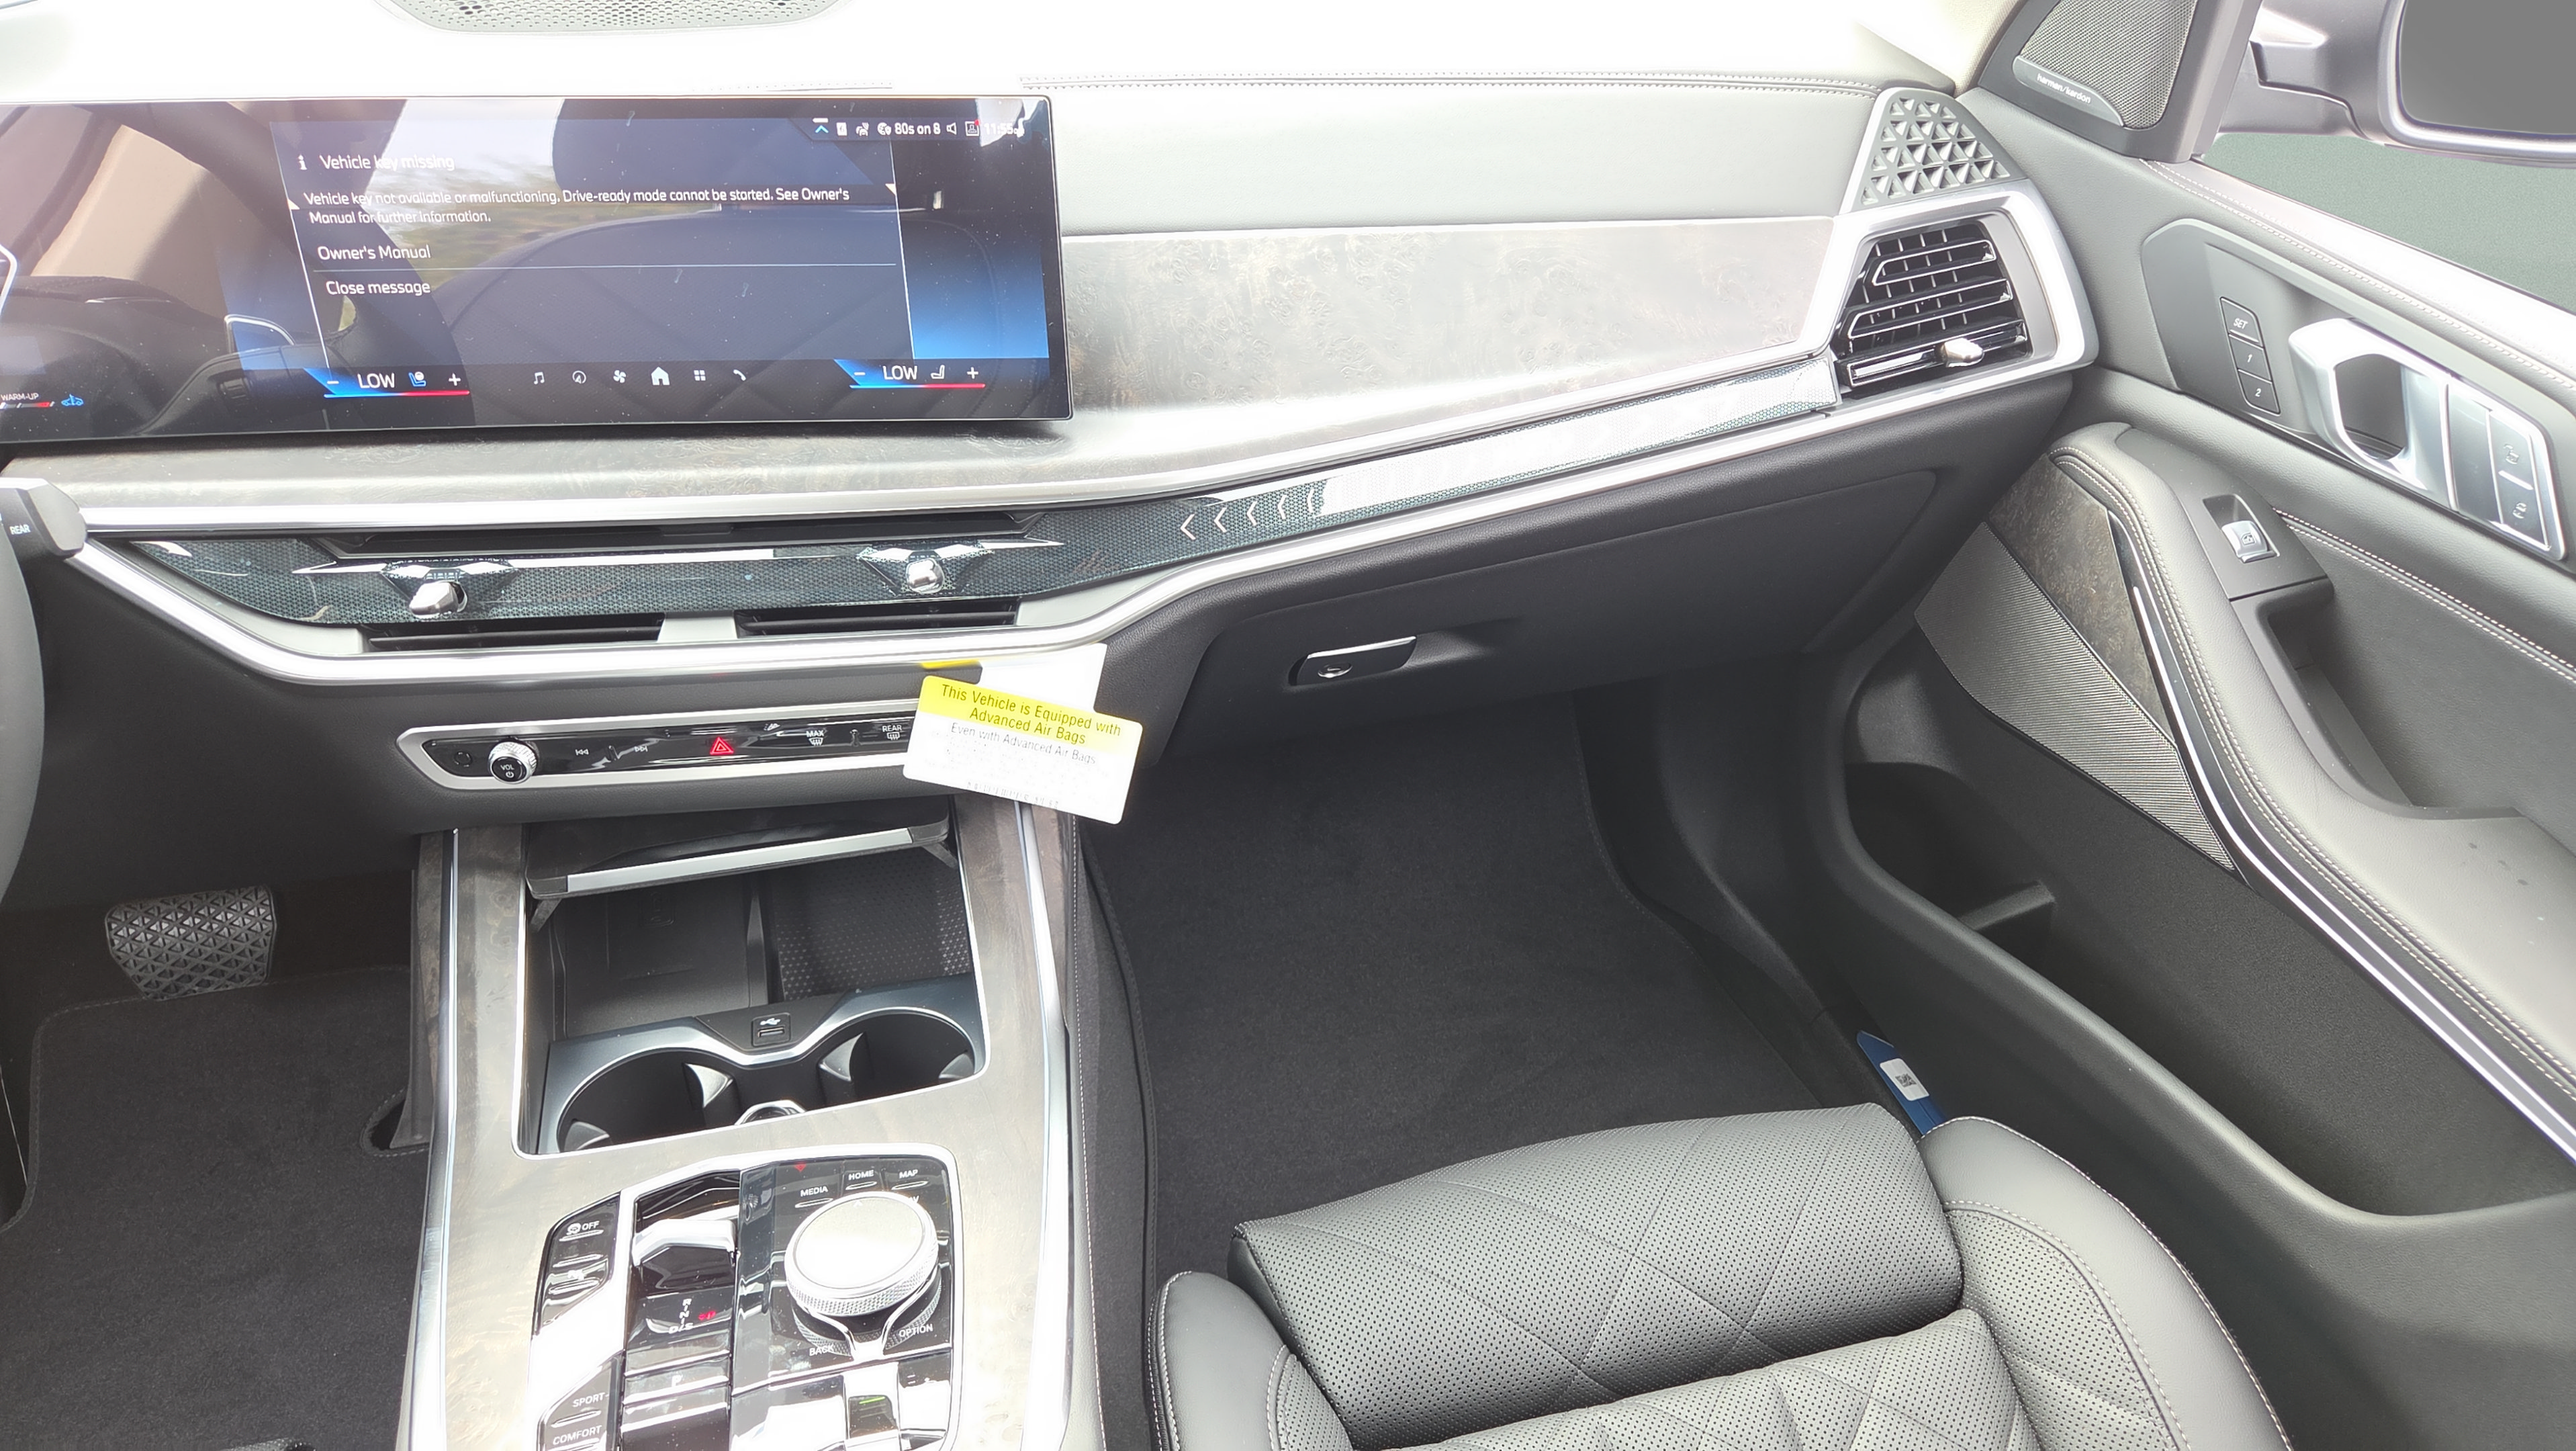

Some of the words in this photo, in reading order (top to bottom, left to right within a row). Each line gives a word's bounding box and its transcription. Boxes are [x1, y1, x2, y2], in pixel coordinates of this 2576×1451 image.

[894, 122, 915, 135] 80s
[917, 125, 931, 134] on
[933, 122, 941, 134] 8
[319, 155, 371, 169] Vehicle
[373, 155, 398, 171] key
[402, 154, 455, 171] missing
[304, 192, 349, 206] Vehicle
[351, 191, 372, 206] key
[375, 193, 397, 204] not
[398, 191, 452, 204] available
[455, 193, 467, 204] or
[469, 189, 561, 206] malfunctioning.
[562, 189, 631, 204] Drive-ready
[633, 189, 667, 202] mode
[670, 189, 710, 202] cannot
[712, 188, 727, 201] be
[729, 188, 774, 201] started.
[776, 187, 799, 201] See
[801, 187, 850, 201] Owner's
[309, 211, 355, 224] Manual
[358, 211, 375, 224] for
[376, 211, 416, 224] further
[419, 210, 492, 223] information.
[317, 245, 377, 261] Owner's
[378, 243, 431, 259] Manual
[326, 280, 365, 296] Close
[367, 282, 431, 297] message
[2233, 317, 2249, 330] SET
[2247, 353, 2253, 363] 1
[882, 365, 918, 380] LOW
[357, 372, 396, 389] LOW
[1, 392, 40, 402] WARM-UP
[2255, 388, 2262, 398] 2
[9, 524, 31, 535] REAR
[941, 683, 967, 702] This
[972, 690, 1017, 713] Vehicle
[1019, 701, 1031, 716] is
[1034, 705, 1093, 730] Equipped
[1095, 721, 1121, 737] with
[882, 723, 903, 733] REAR
[969, 707, 1031, 732] Advanced
[1034, 721, 1052, 737] Air
[1056, 726, 1087, 746] Bags
[807, 730, 825, 738] MAX
[950, 722, 976, 737] Even
[979, 730, 1001, 743] with
[1002, 734, 1053, 755] Advanced
[1054, 745, 1068, 758] Air
[1071, 748, 1097, 766] Bags
[847, 1169, 875, 1181] HOME
[899, 1169, 919, 1179] MAP
[800, 1185, 829, 1198] MEDIA
[582, 1220, 600, 1231] OFF
[898, 1323, 933, 1338] OPTION
[809, 1344, 835, 1356] BACK
[552, 1425, 602, 1446] COMFORT
